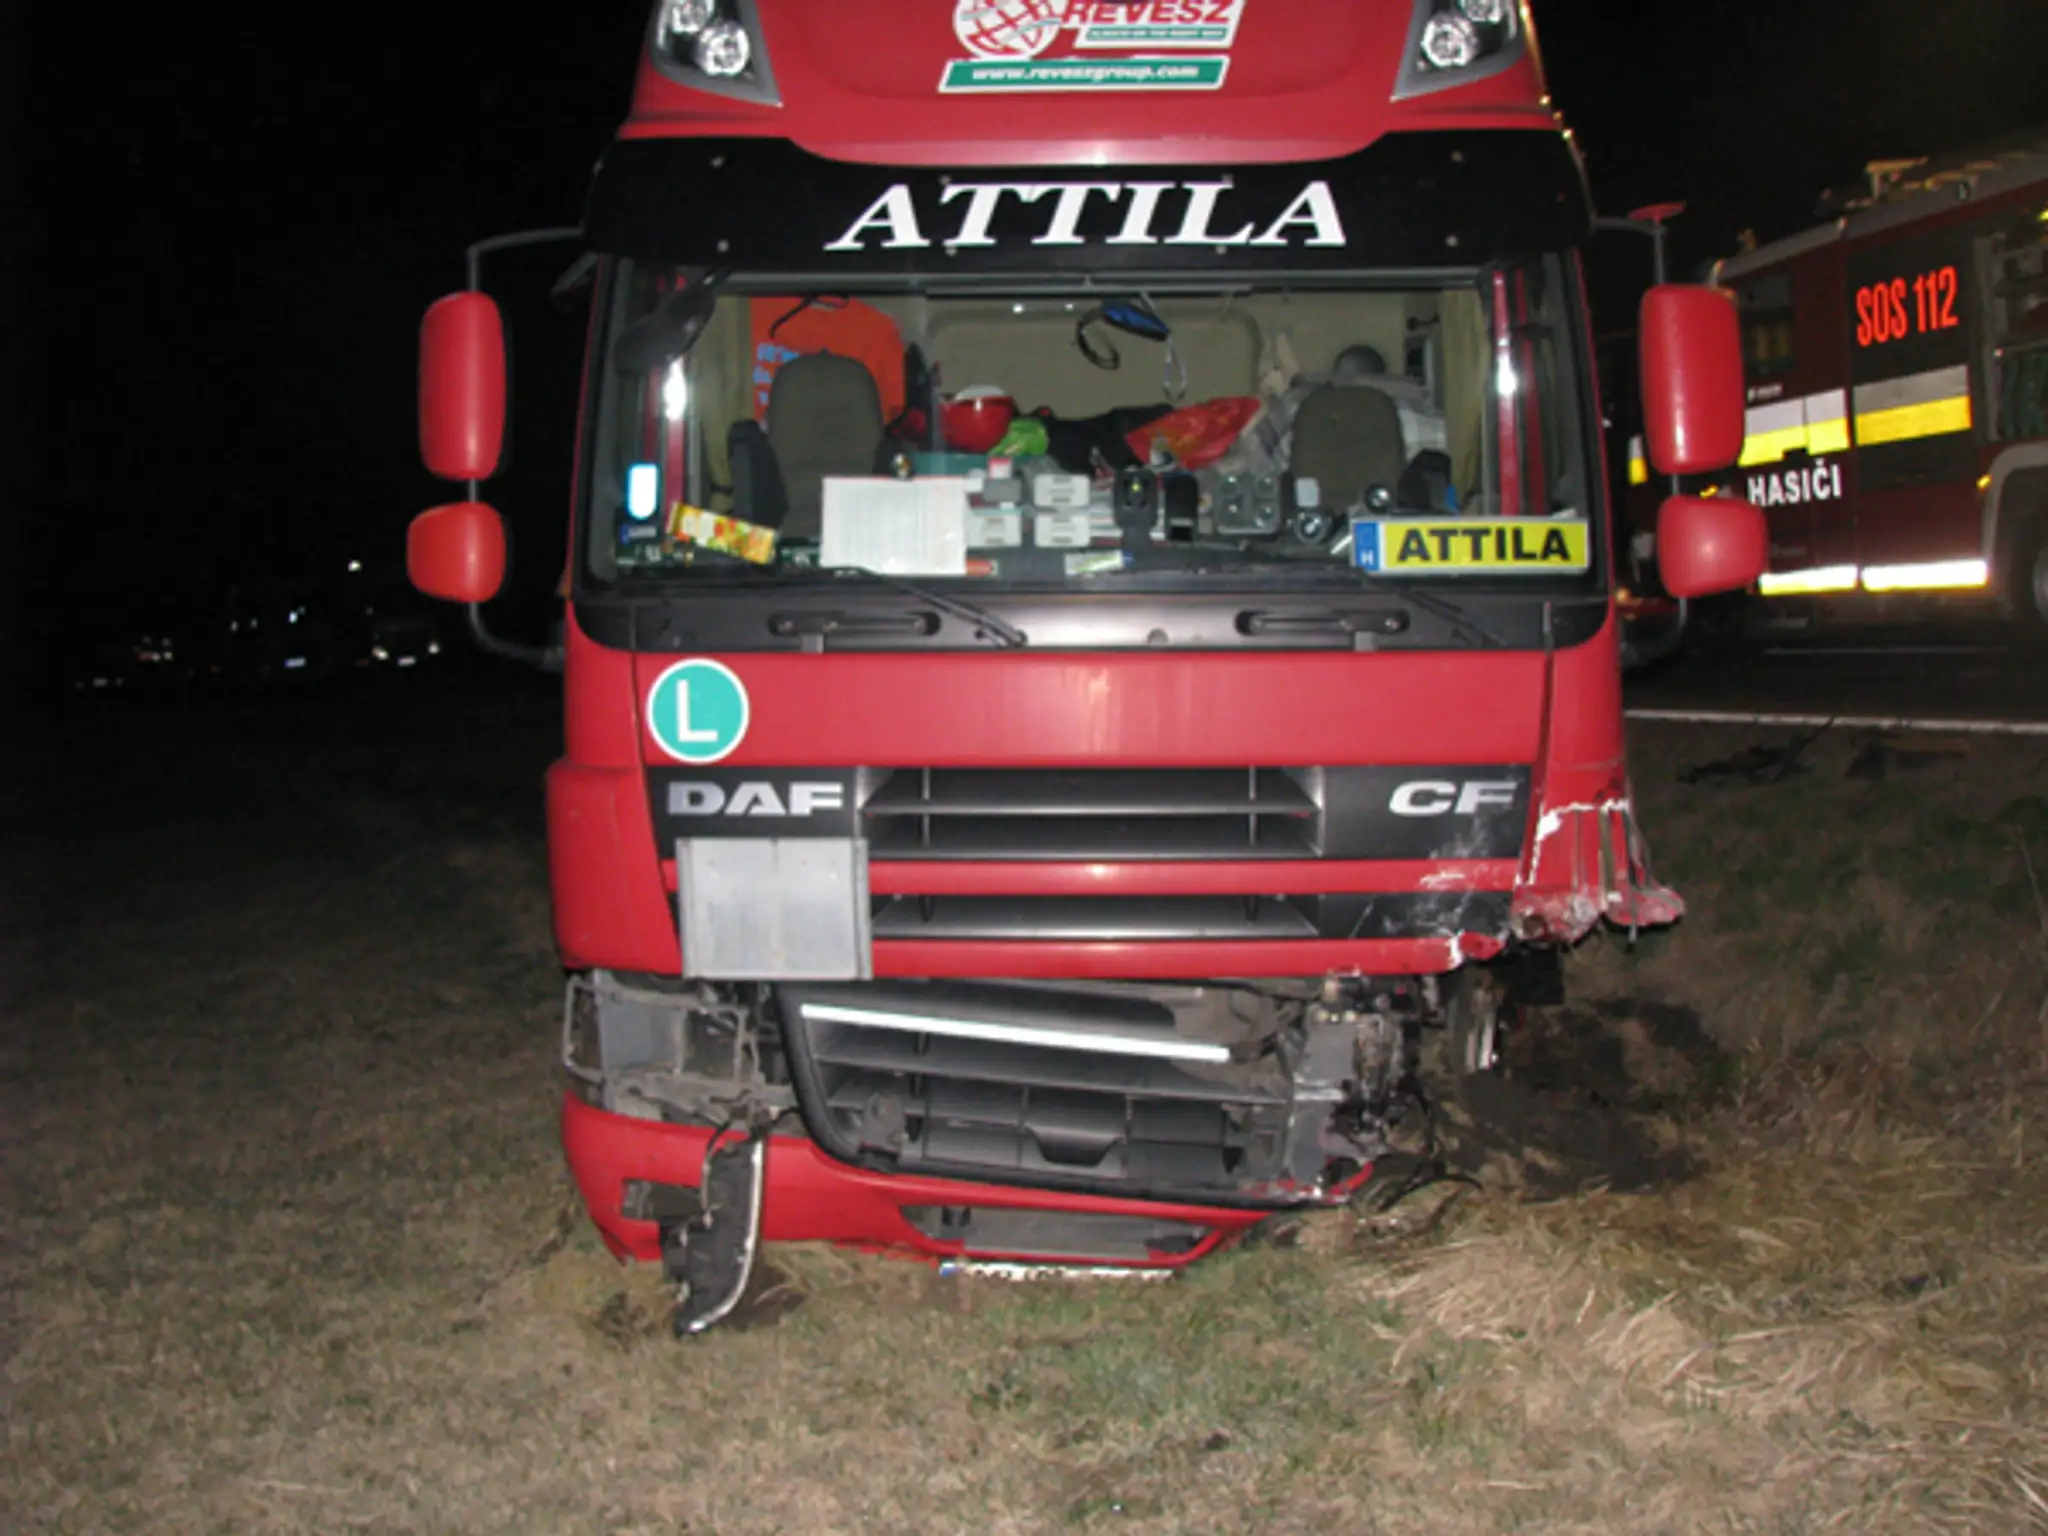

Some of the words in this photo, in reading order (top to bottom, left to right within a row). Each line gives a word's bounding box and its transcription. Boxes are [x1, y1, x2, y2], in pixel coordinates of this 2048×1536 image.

[823, 180, 1346, 251] ATTILA
[1856, 276, 1907, 347] SOS
[1912, 265, 1959, 334] 112
[1747, 457, 1842, 507] HASIČI
[1397, 527, 1571, 562] ATTILA
[677, 679, 718, 742] L
[667, 781, 844, 816] DAF
[1389, 780, 1518, 817] CF
